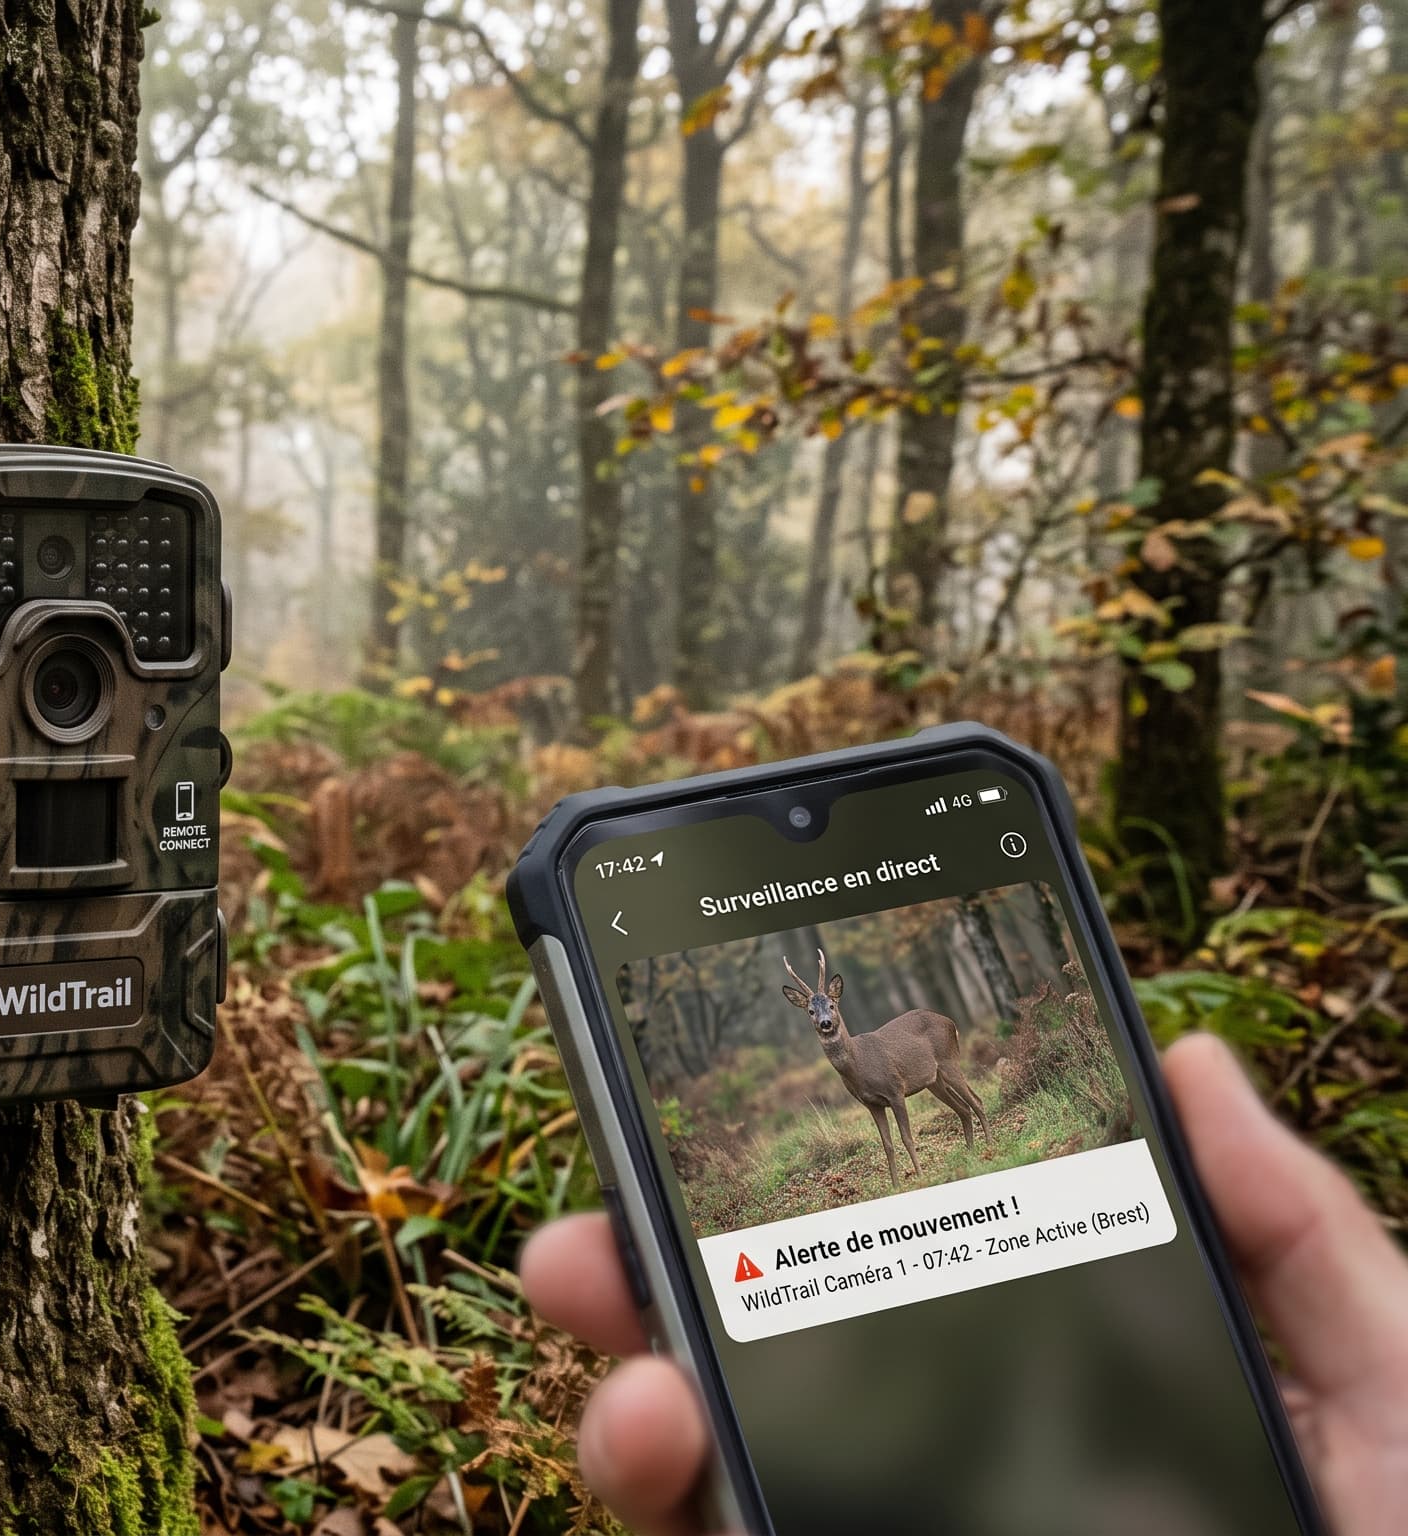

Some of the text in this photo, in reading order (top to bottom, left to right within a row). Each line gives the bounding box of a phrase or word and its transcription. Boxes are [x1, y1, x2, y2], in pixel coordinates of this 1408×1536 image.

[952, 792, 973, 809] 4G
[163, 825, 207, 838] REMOTE
[159, 838, 211, 851] CONNECT
[595, 855, 647, 880] 17:42
[699, 853, 941, 918] Surveillance en direct
[775, 1196, 1021, 1271] Alerte de mouvement !
[741, 1279, 821, 1313] WildTrail
[824, 1263, 893, 1293] Caméra
[896, 1259, 907, 1276] 1
[923, 1244, 973, 1271] 07:42
[985, 1234, 1030, 1257] Zone
[1035, 1217, 1088, 1245] Active
[1092, 1202, 1151, 1236] (Brest)
